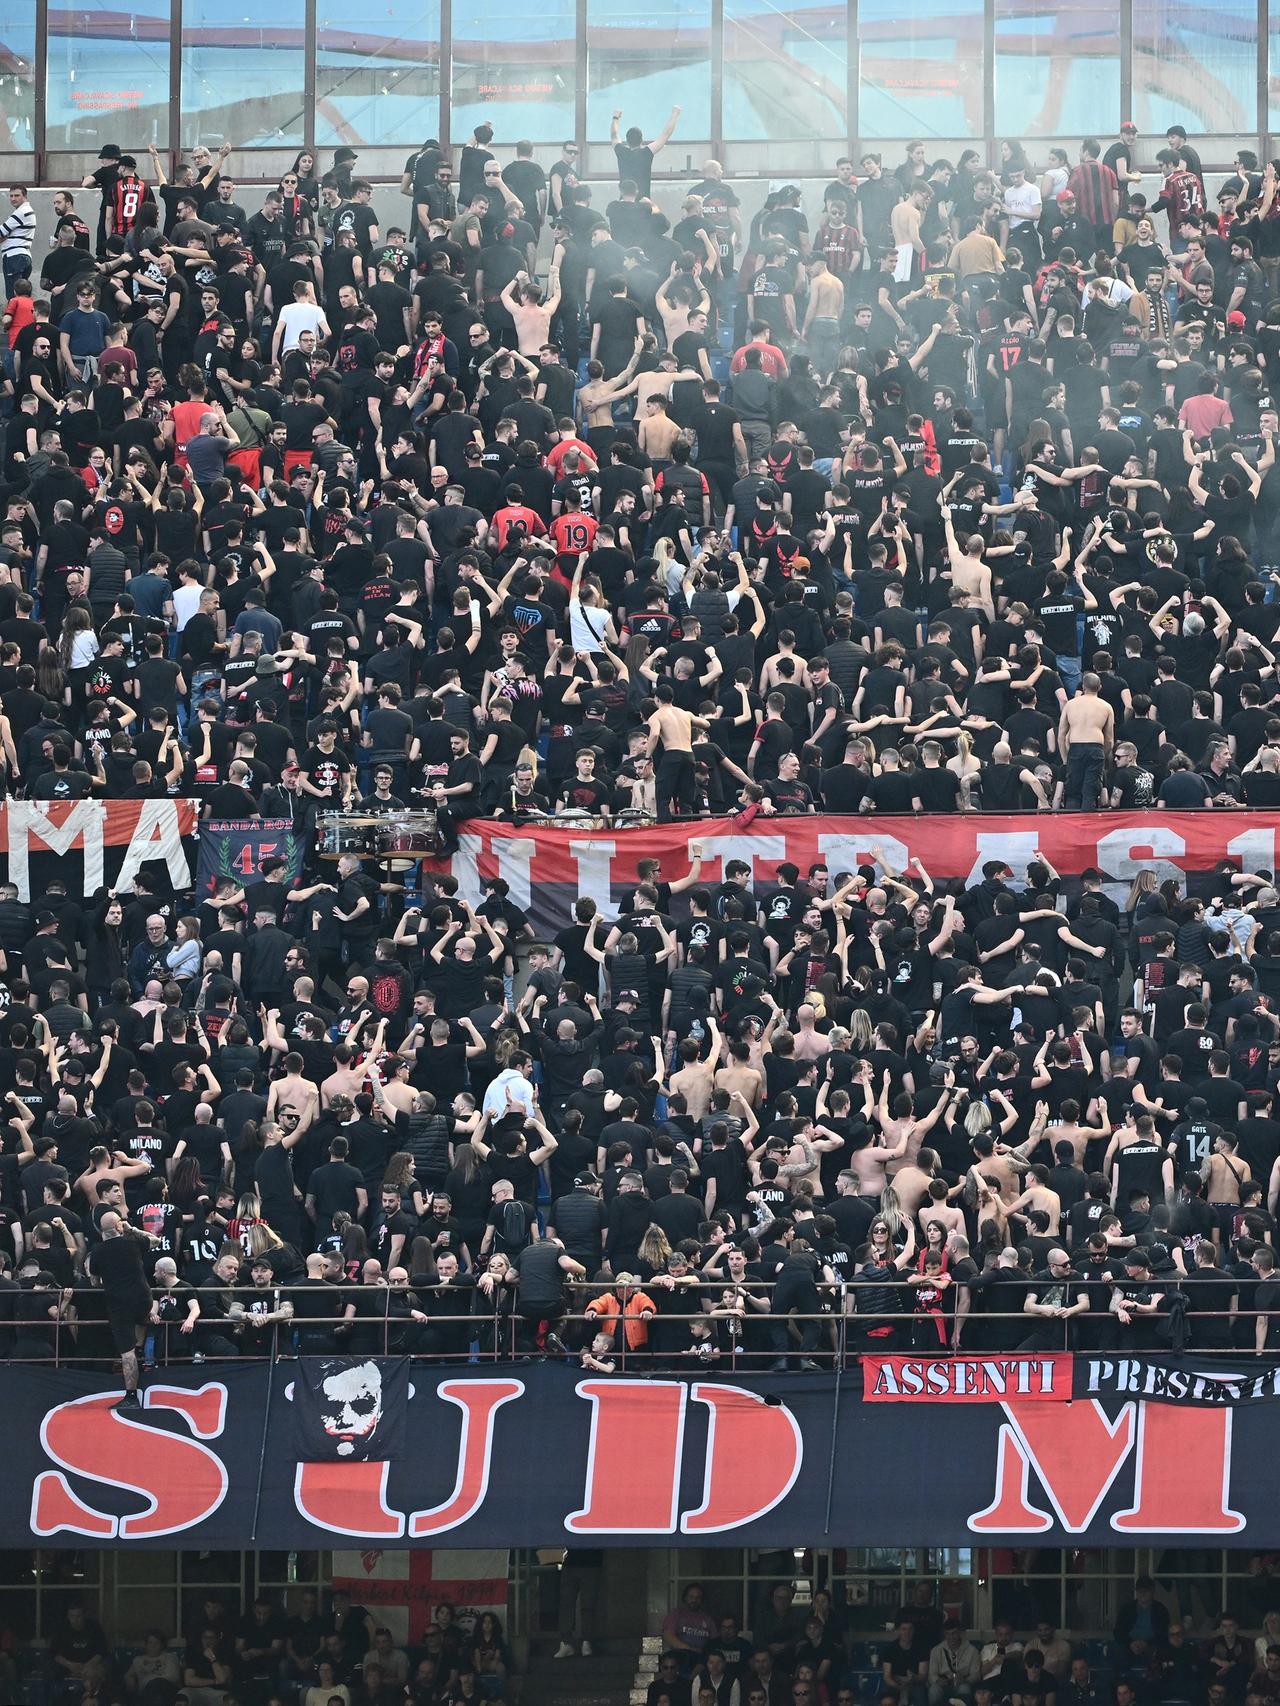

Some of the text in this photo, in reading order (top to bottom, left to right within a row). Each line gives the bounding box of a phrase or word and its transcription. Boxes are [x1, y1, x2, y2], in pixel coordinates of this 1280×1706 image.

[123, 193, 138, 217] 8
[1181, 187, 1201, 211] 34
[1000, 345, 1021, 369] 17
[564, 525, 589, 549] 19
[209, 821, 260, 831] BANDA
[452, 827, 1188, 922] ULTRAS
[131, 1138, 162, 1151] MILANO
[1186, 1135, 1210, 1161] 14
[191, 1239, 217, 1261] 10
[873, 1361, 1055, 1396] ASSENTI
[30, 1377, 804, 1540] SUD
